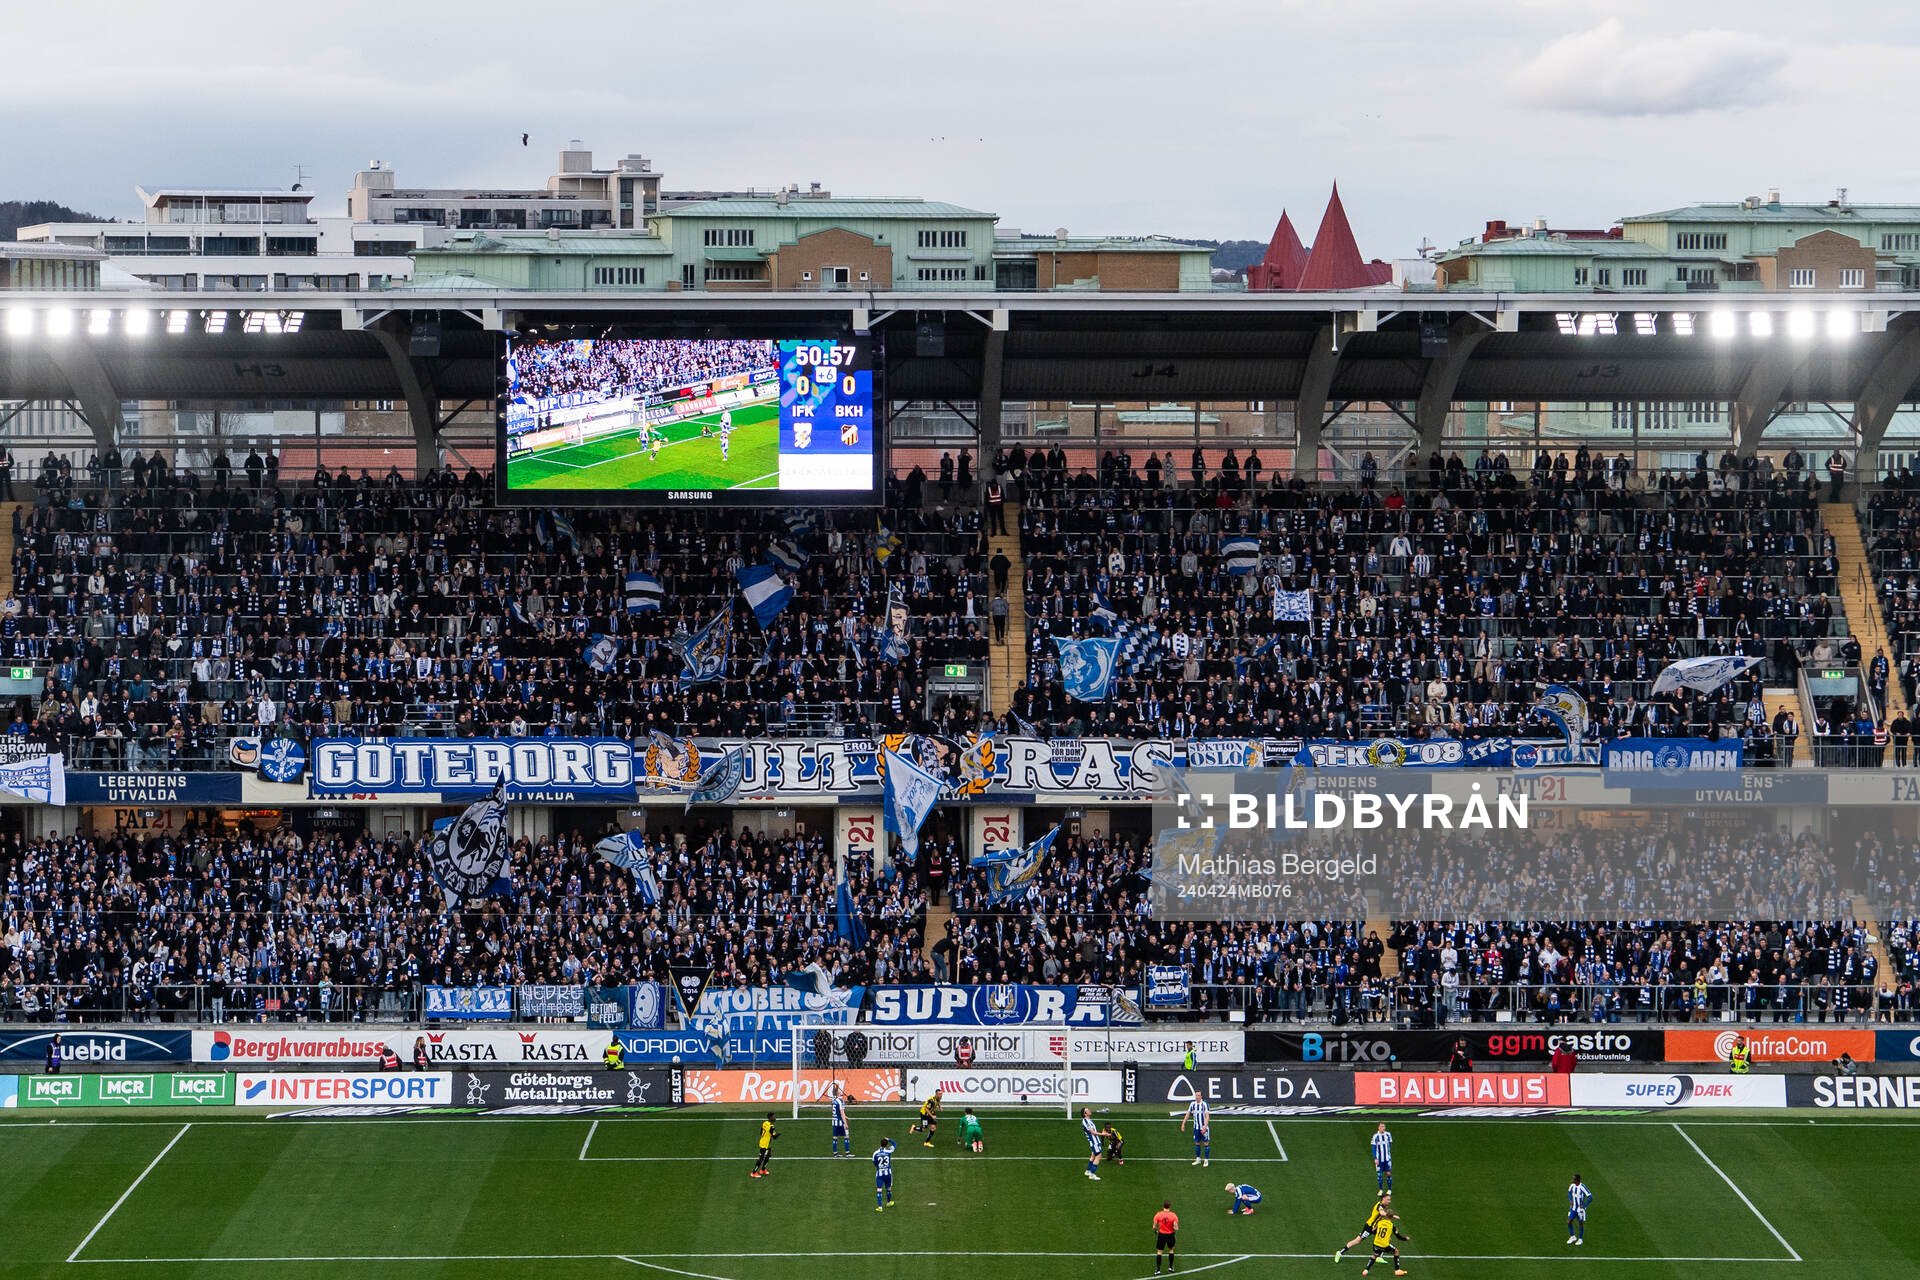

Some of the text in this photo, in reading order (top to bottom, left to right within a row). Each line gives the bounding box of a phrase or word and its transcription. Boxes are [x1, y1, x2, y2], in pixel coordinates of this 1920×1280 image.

[796, 346, 856, 366] 50:57
[796, 375, 856, 396] 0 0
[791, 405, 864, 417] IFK BKH
[668, 491, 713, 500] SAMSUNG
[0, 743, 47, 754] BROWN
[844, 742, 875, 751] EROL
[1189, 741, 1243, 752] SEKTION
[316, 737, 633, 788] GÖTEBORG
[1189, 751, 1243, 766] OSLO
[99, 776, 187, 787] LEGENDENS
[109, 789, 178, 801] UTVALDA
[1695, 790, 1764, 802] UTVALDA
[590, 1002, 618, 1014] BETONG
[699, 987, 801, 1015] KTOBER
[60, 1038, 126, 1061] uebid
[430, 1043, 498, 1061] RASTA
[521, 1043, 589, 1061] RASTA
[1746, 1036, 1827, 1056] InfraCom
[1575, 1052, 1631, 1062] köksutrustning
[35, 1079, 217, 1095] MCR MCR MCR
[510, 1073, 593, 1088] Göteborgs
[671, 1068, 682, 1103] SELECT
[739, 1071, 846, 1102] Renova
[1125, 1068, 1136, 1103] SELECT
[1379, 1076, 1545, 1100] BAUHAUS
[270, 1077, 441, 1100] INTERSPORT
[504, 1087, 615, 1101] Metallpartier
[1208, 1077, 1322, 1100] ELEDA
[1625, 1083, 1676, 1097] SUPER
[1813, 1075, 1920, 1108] SERNE
[877, 1156, 890, 1168] 23
[1376, 1225, 1388, 1239] 16
